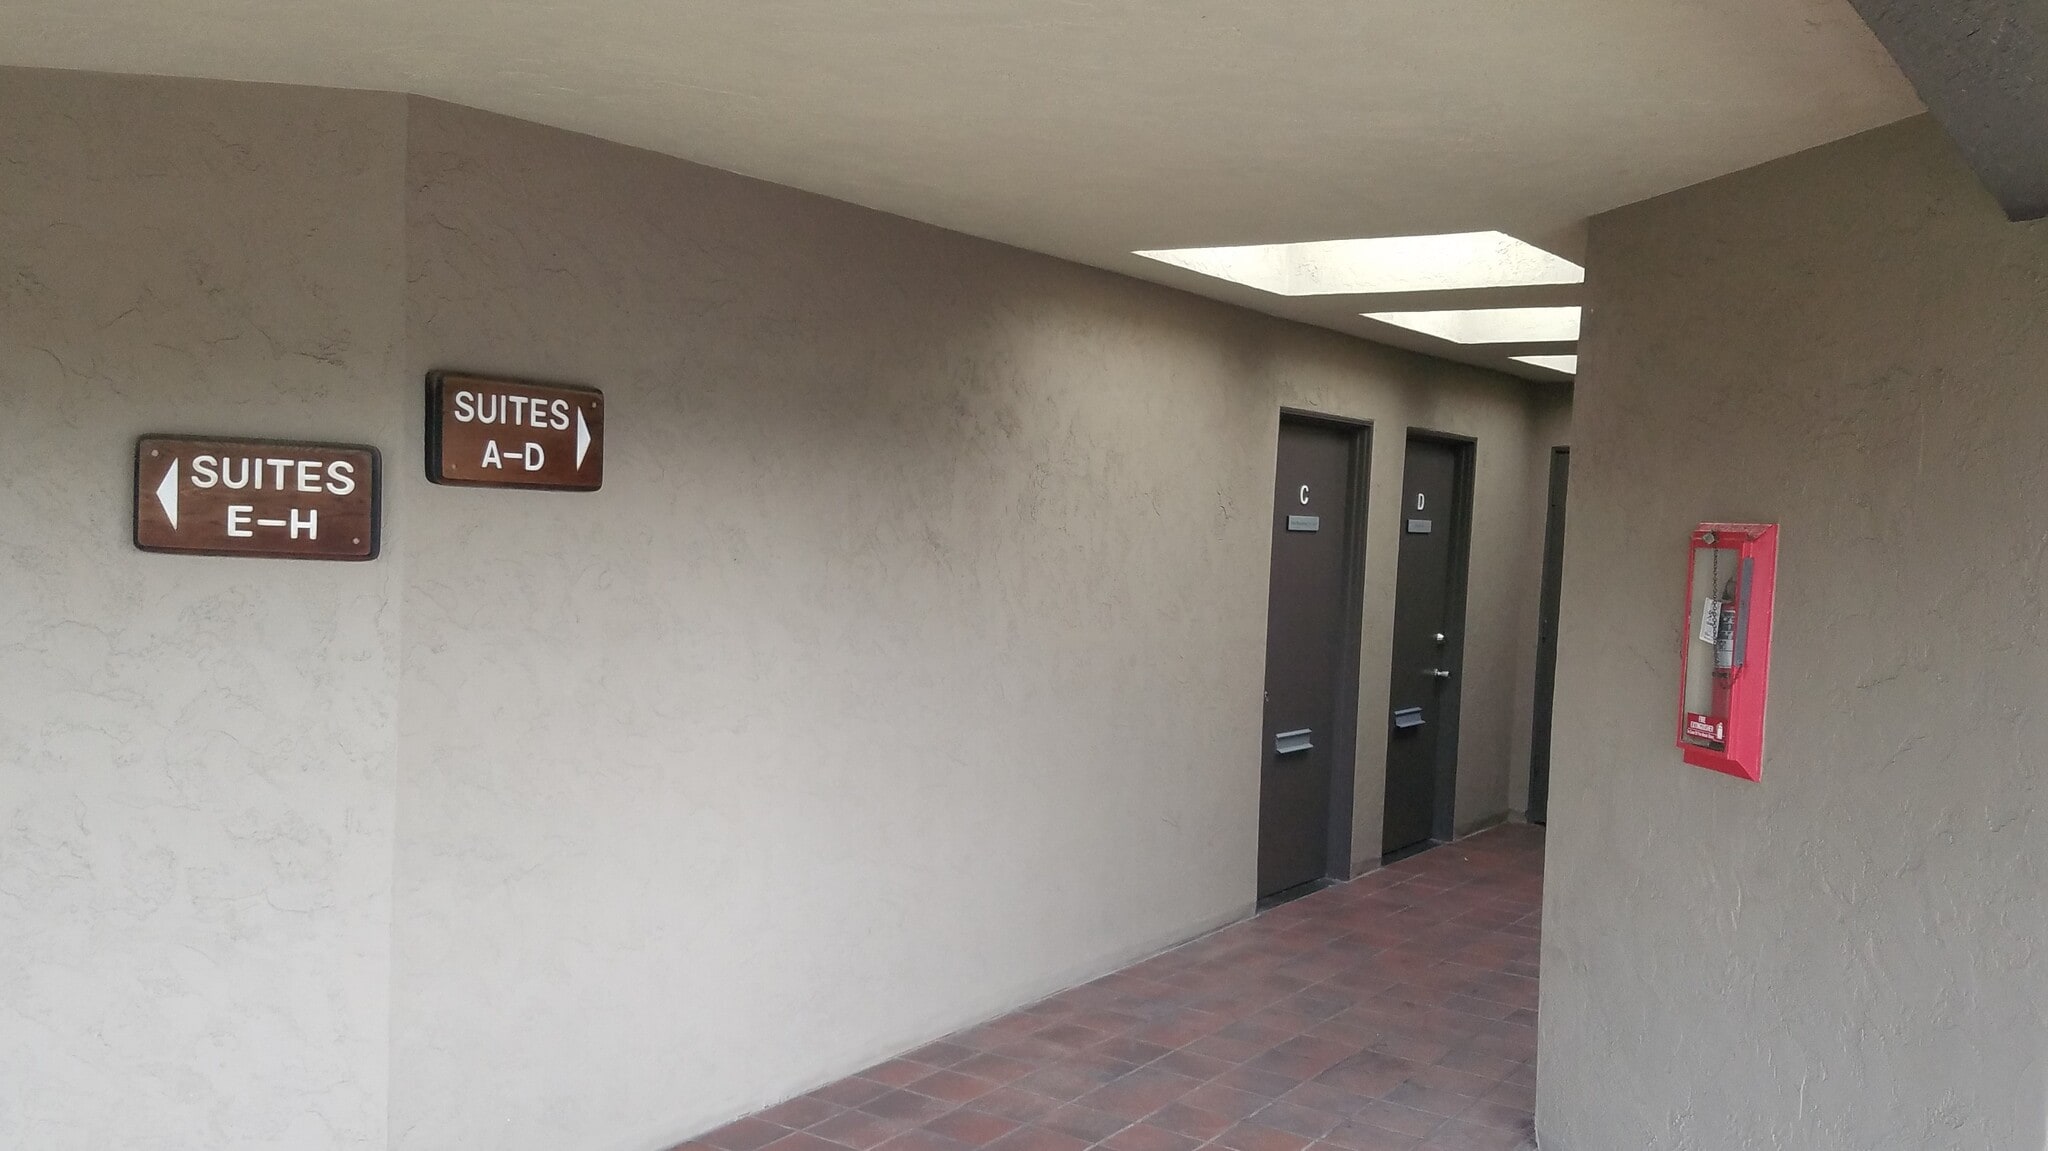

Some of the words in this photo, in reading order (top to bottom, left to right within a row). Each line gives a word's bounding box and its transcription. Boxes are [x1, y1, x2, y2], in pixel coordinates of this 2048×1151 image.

[454, 391, 570, 431] SUITES
[481, 439, 545, 471] A-D
[191, 455, 356, 496] SUITES
[1300, 484, 1309, 505] C
[1417, 493, 1425, 511] D
[227, 505, 318, 540] E-H
